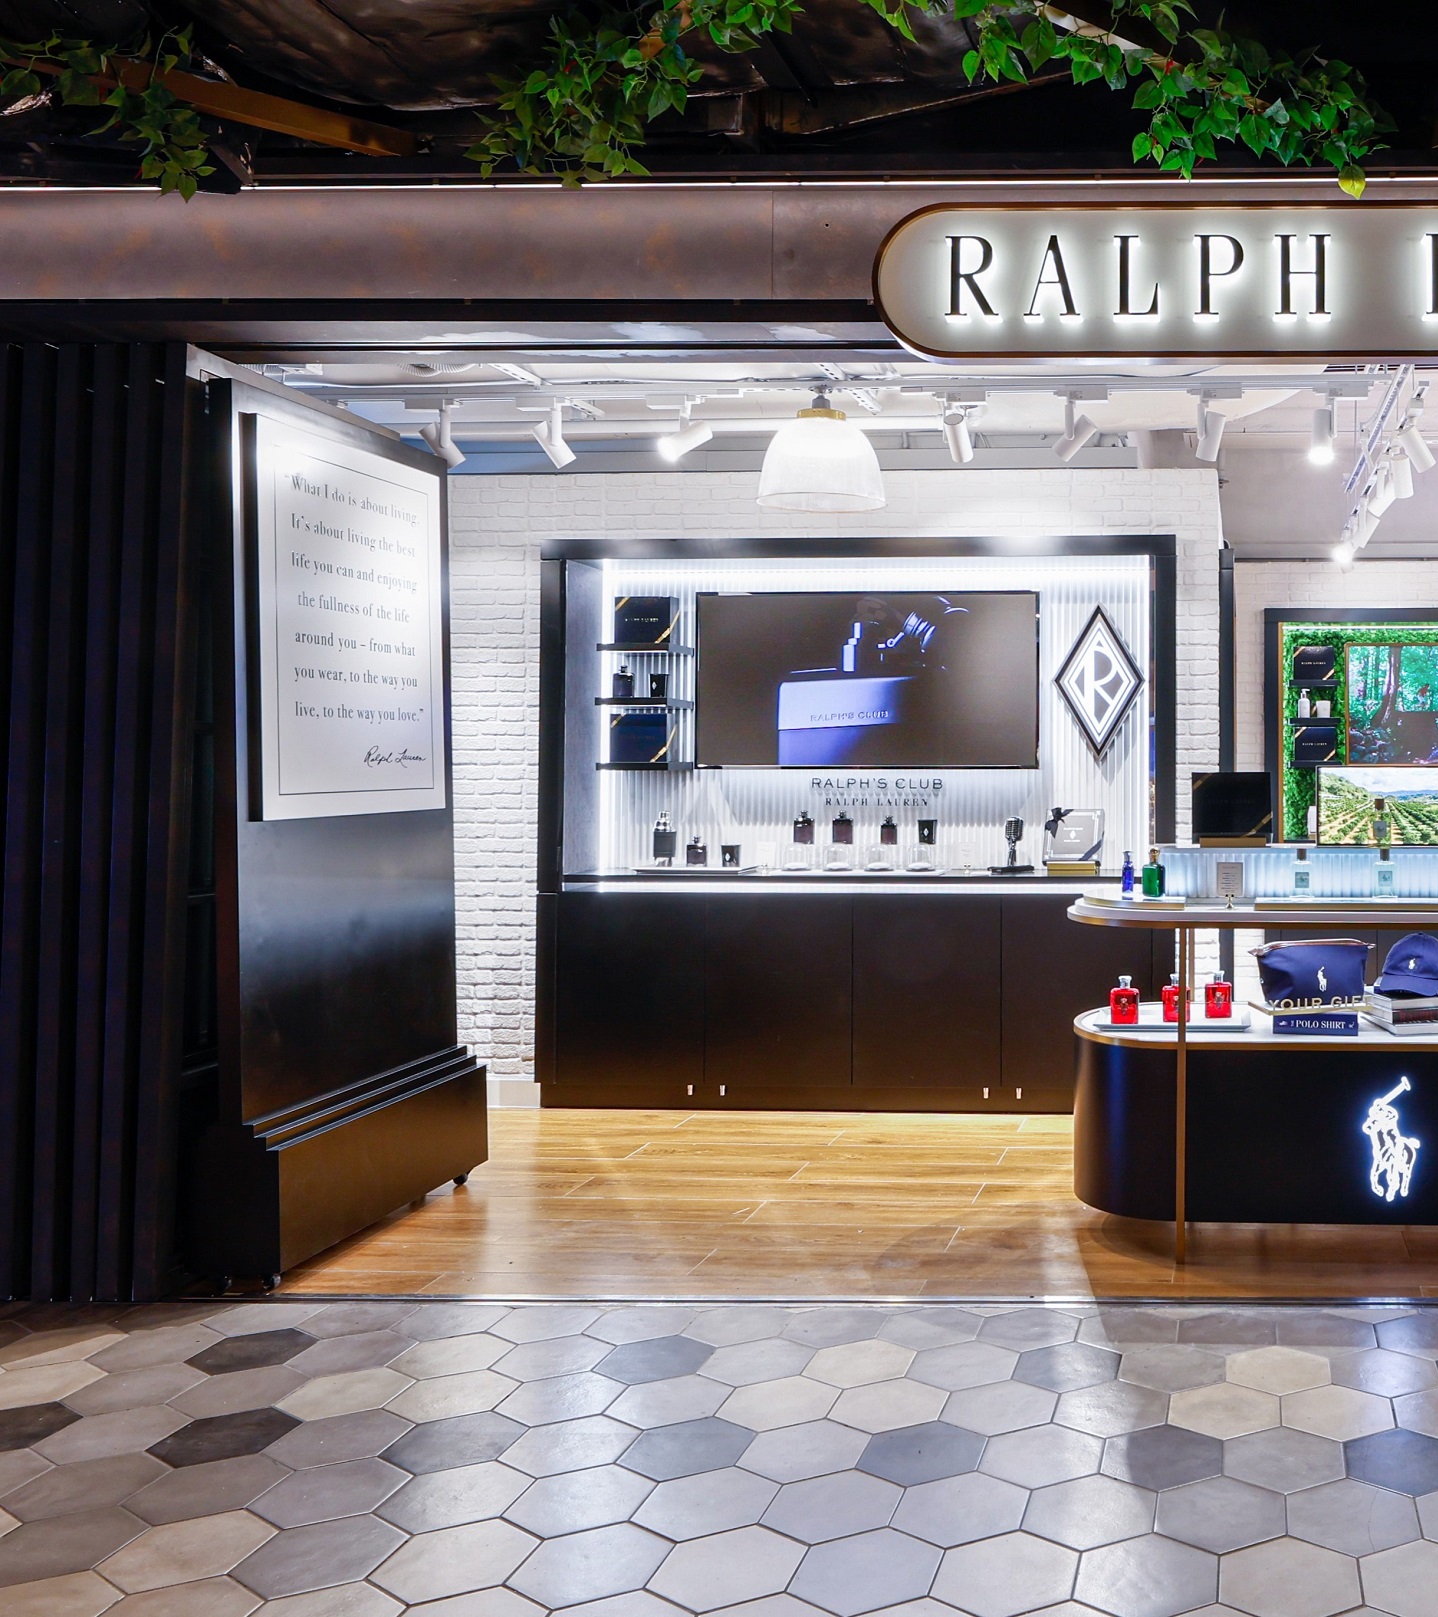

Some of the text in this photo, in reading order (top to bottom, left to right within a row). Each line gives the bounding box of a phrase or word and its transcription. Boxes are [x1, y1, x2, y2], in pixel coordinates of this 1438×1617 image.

[944, 233, 1334, 322] RALPH
[324, 483, 329, 499] I
[332, 487, 345, 503] do
[348, 492, 357, 506] is
[360, 497, 389, 516] about
[391, 504, 420, 527] living.
[291, 513, 415, 558] It's about living the best
[291, 551, 418, 595] life you can and enjoying
[297, 591, 410, 623] the fullness of the life
[295, 631, 334, 647] around
[338, 639, 357, 652] you
[369, 638, 392, 654] from
[394, 642, 416, 657] what
[294, 666, 418, 691] you wear, to the way you
[295, 701, 320, 719] live,
[323, 706, 334, 718] to
[337, 703, 354, 719] the
[357, 709, 376, 724] way
[378, 709, 395, 724] you
[858, 710, 889, 719] CLUB
[364, 745, 427, 768] Ralph Lauren
[811, 777, 943, 790] RALPH'S CLUB
[825, 797, 928, 807] RALPH LAUREN
[1268, 995, 1374, 1012] YOUR GIFT
[1295, 1020, 1319, 1029] POLO
[1320, 1020, 1346, 1030] SHIRT
